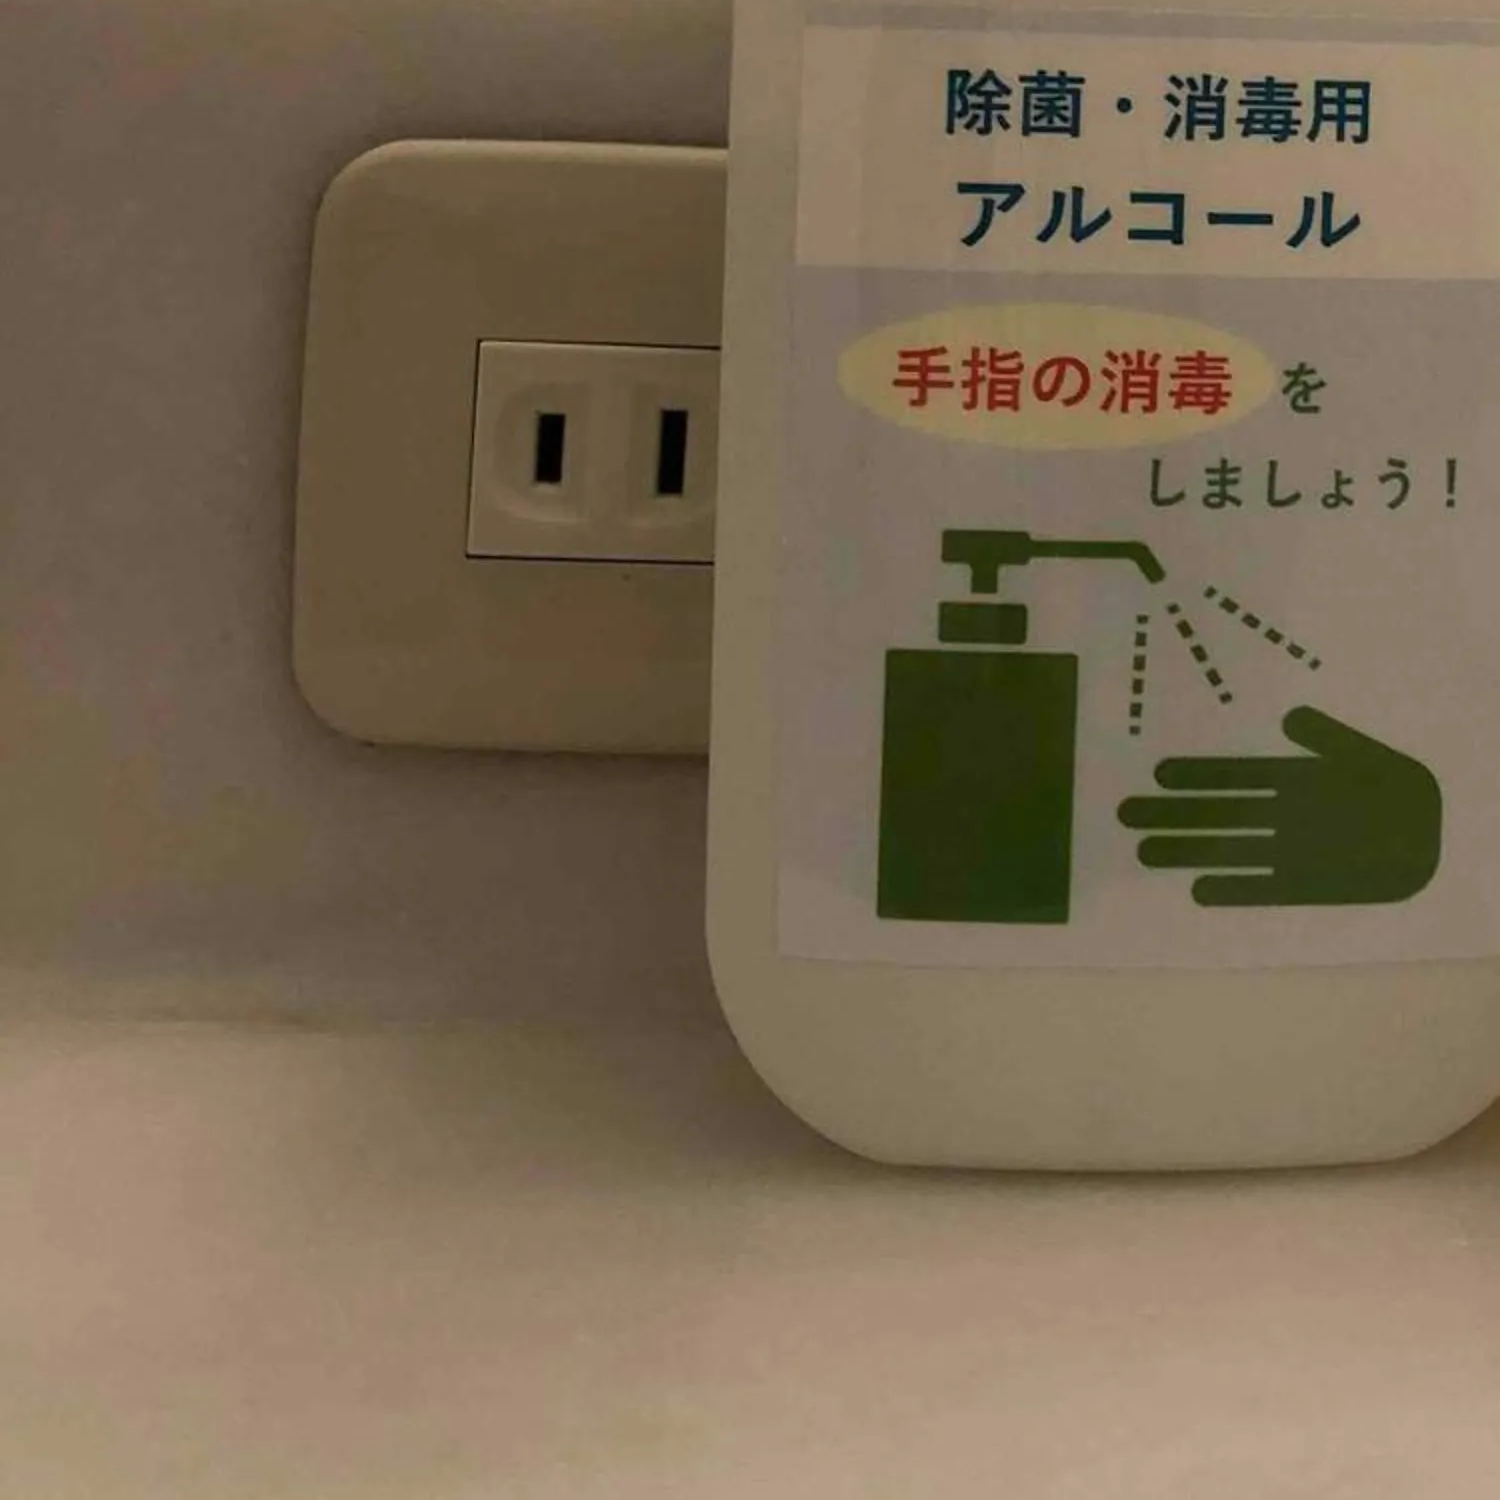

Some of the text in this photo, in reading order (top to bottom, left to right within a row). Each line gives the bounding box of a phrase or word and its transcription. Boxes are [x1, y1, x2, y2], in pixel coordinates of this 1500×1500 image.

[944, 68, 1373, 144] 除菌・消毒用
[956, 181, 1362, 249] アルコール
